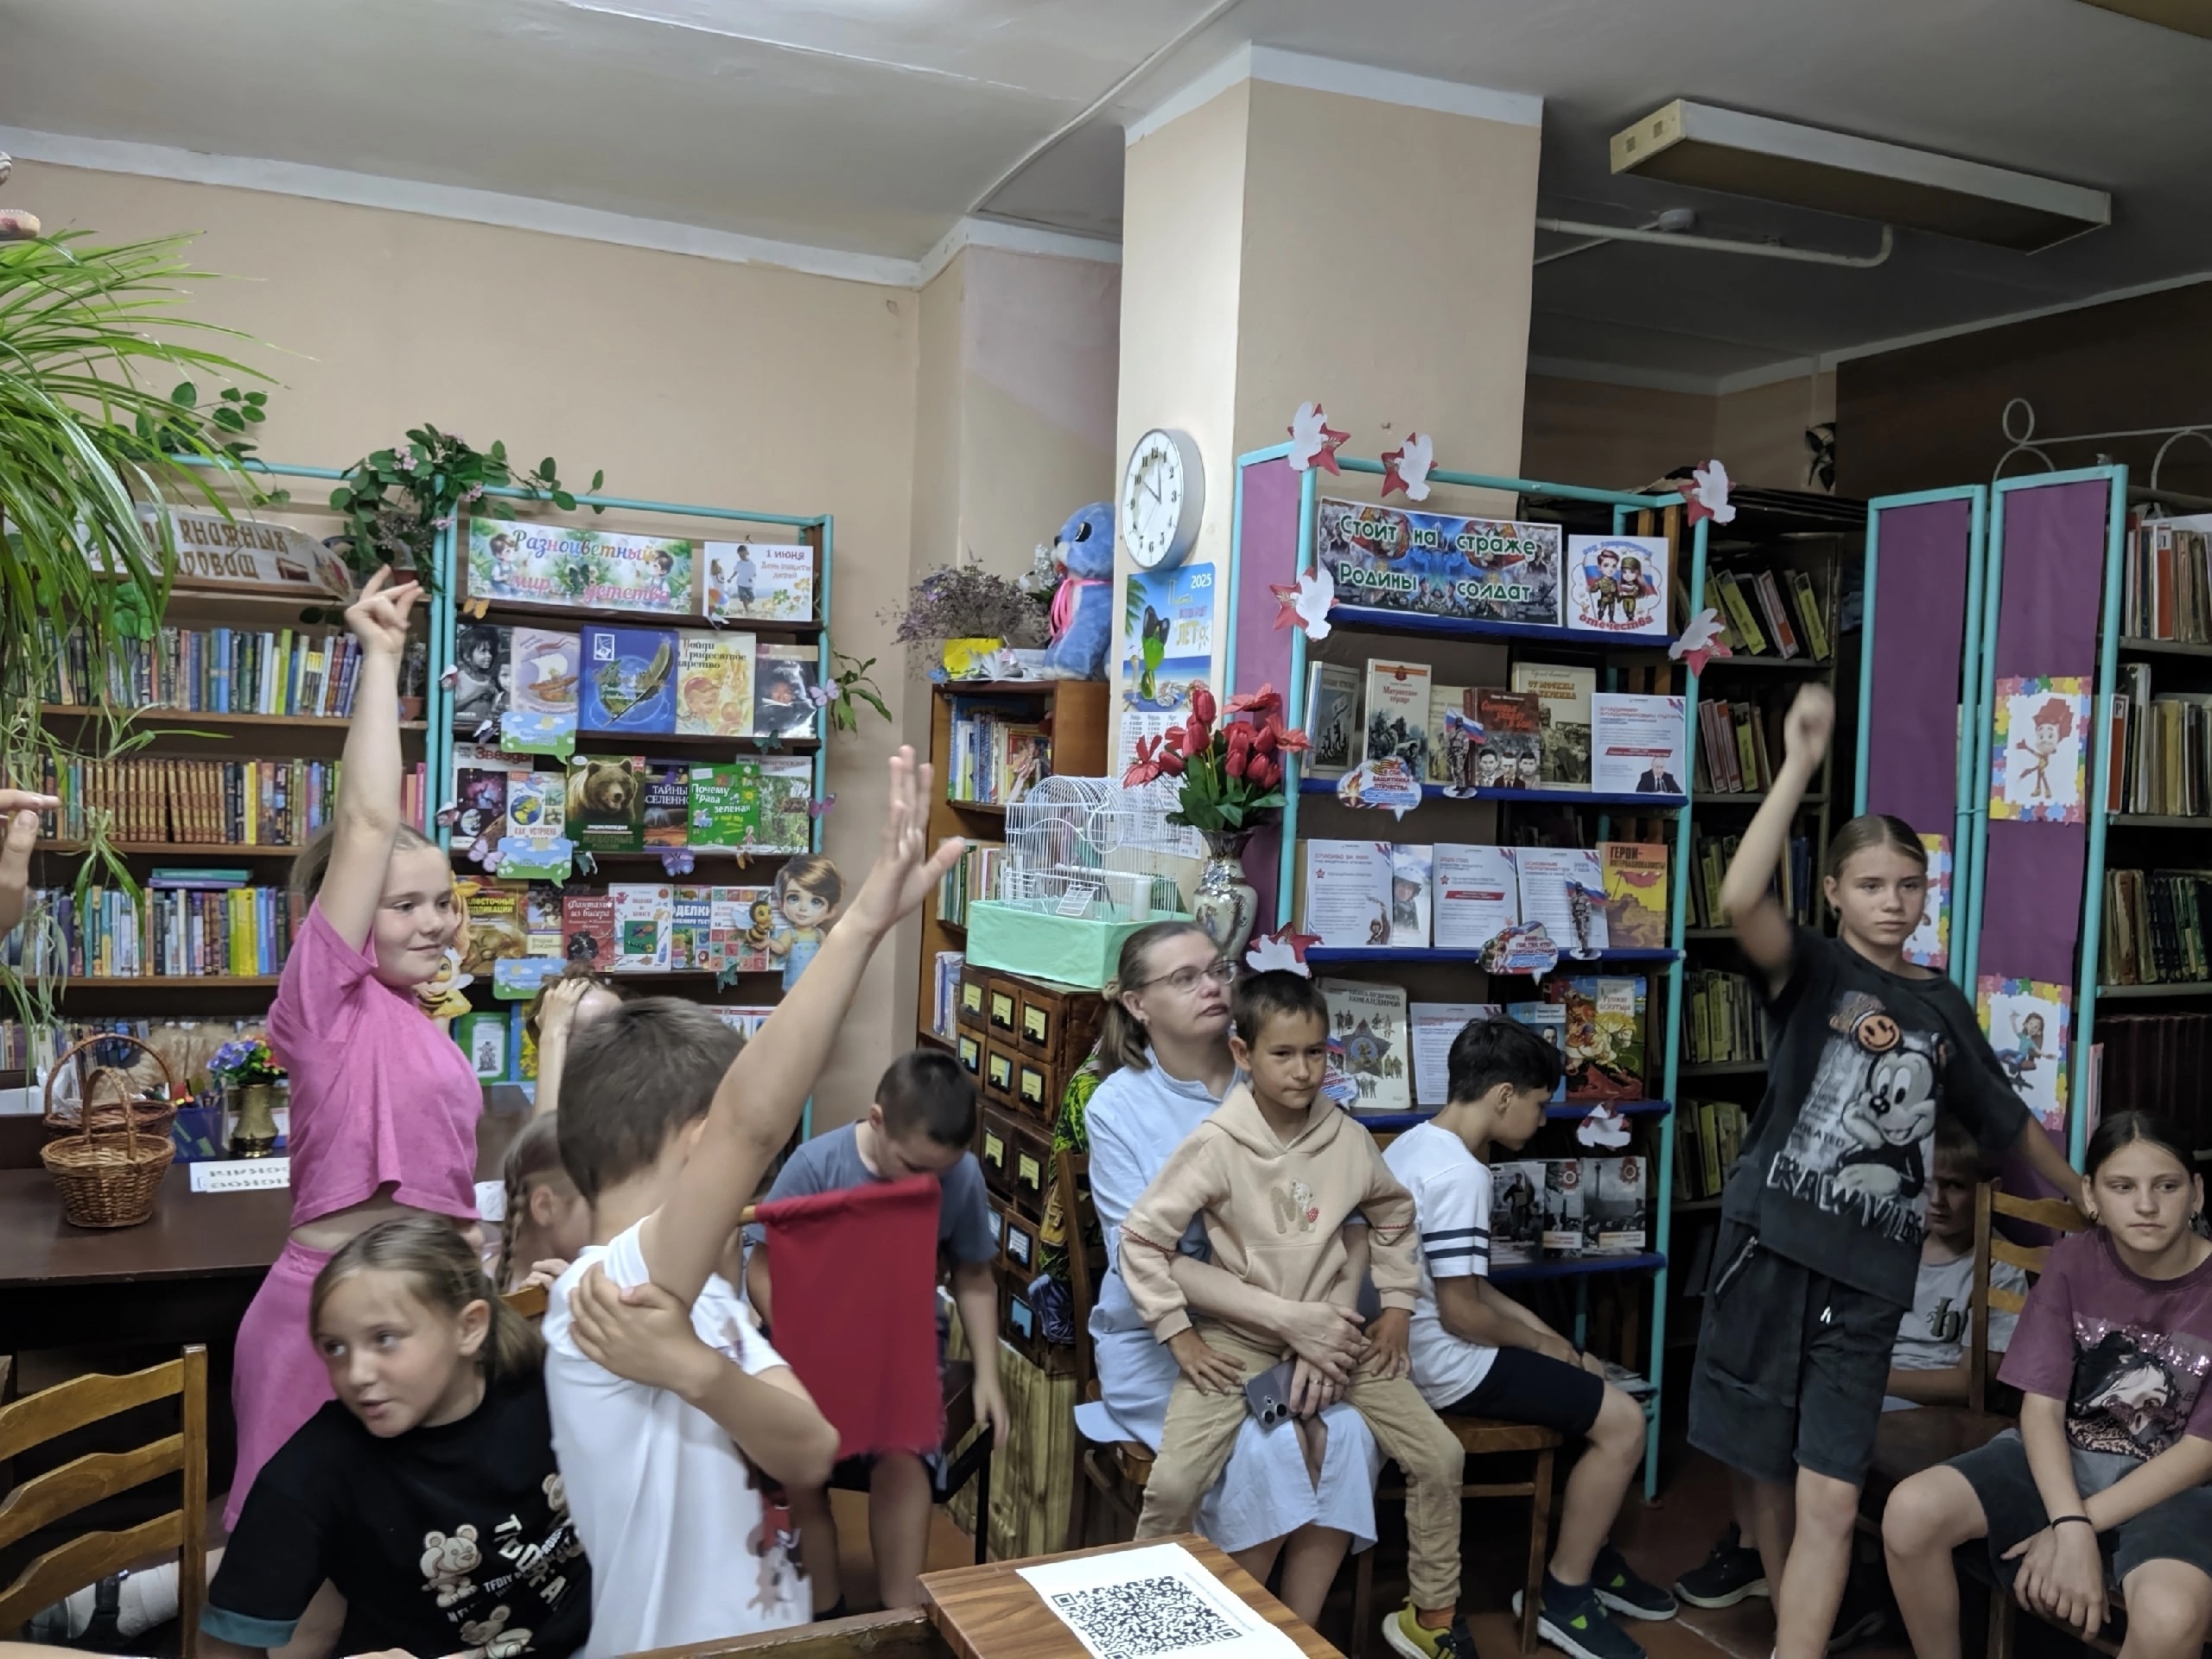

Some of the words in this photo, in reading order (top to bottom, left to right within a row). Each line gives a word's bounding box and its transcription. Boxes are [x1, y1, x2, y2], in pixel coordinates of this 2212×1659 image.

[1340, 514, 1397, 541] Стоит
[1414, 530, 1438, 546] на
[1456, 533, 1536, 556] страже
[512, 530, 656, 563] Разноцветный
[1191, 574, 1211, 588] 2025
[1340, 563, 1420, 591] Родины
[1455, 583, 1532, 601] солдат
[512, 576, 551, 593] мир
[583, 584, 670, 603] детства
[1579, 613, 1654, 630] отечества
[683, 639, 715, 652] Войди
[684, 650, 747, 662] Тридесятое
[652, 784, 688, 795] ТАЙНЫ
[691, 784, 730, 797] Почему
[645, 795, 690, 804] СЕЛЕНН
[696, 794, 721, 804] трава
[583, 908, 610, 919] бисера
[1349, 995, 1401, 1007] КОМАНДИРОВ
